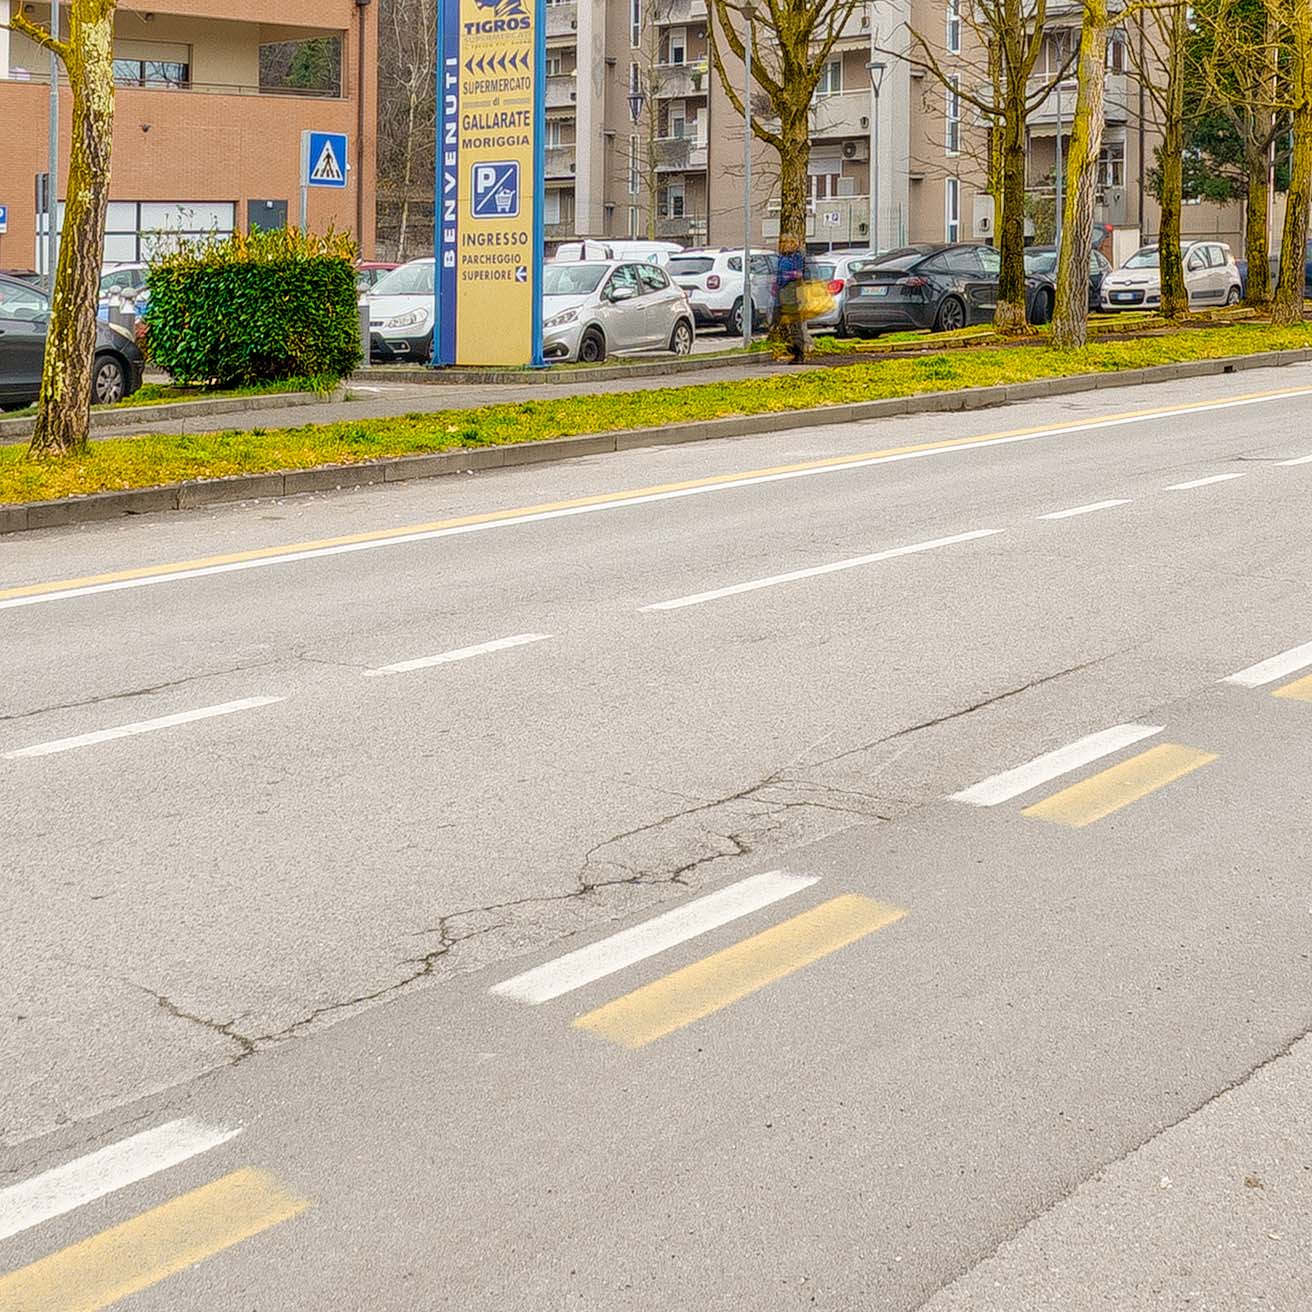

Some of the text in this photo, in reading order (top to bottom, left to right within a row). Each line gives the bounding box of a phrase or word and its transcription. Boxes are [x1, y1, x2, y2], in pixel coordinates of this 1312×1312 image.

[464, 16, 531, 35] TIGROS
[463, 76, 531, 95] SUPERMERCATO
[492, 97, 500, 106] di
[462, 110, 531, 131] GALLARATE
[462, 135, 530, 149] MORIGGIA
[443, 58, 458, 268] BENVENUTI
[477, 167, 496, 193] P
[462, 231, 528, 247] INGRESSO
[462, 253, 521, 265] PARCHEGGIO
[462, 270, 512, 281] SUPERIORE
